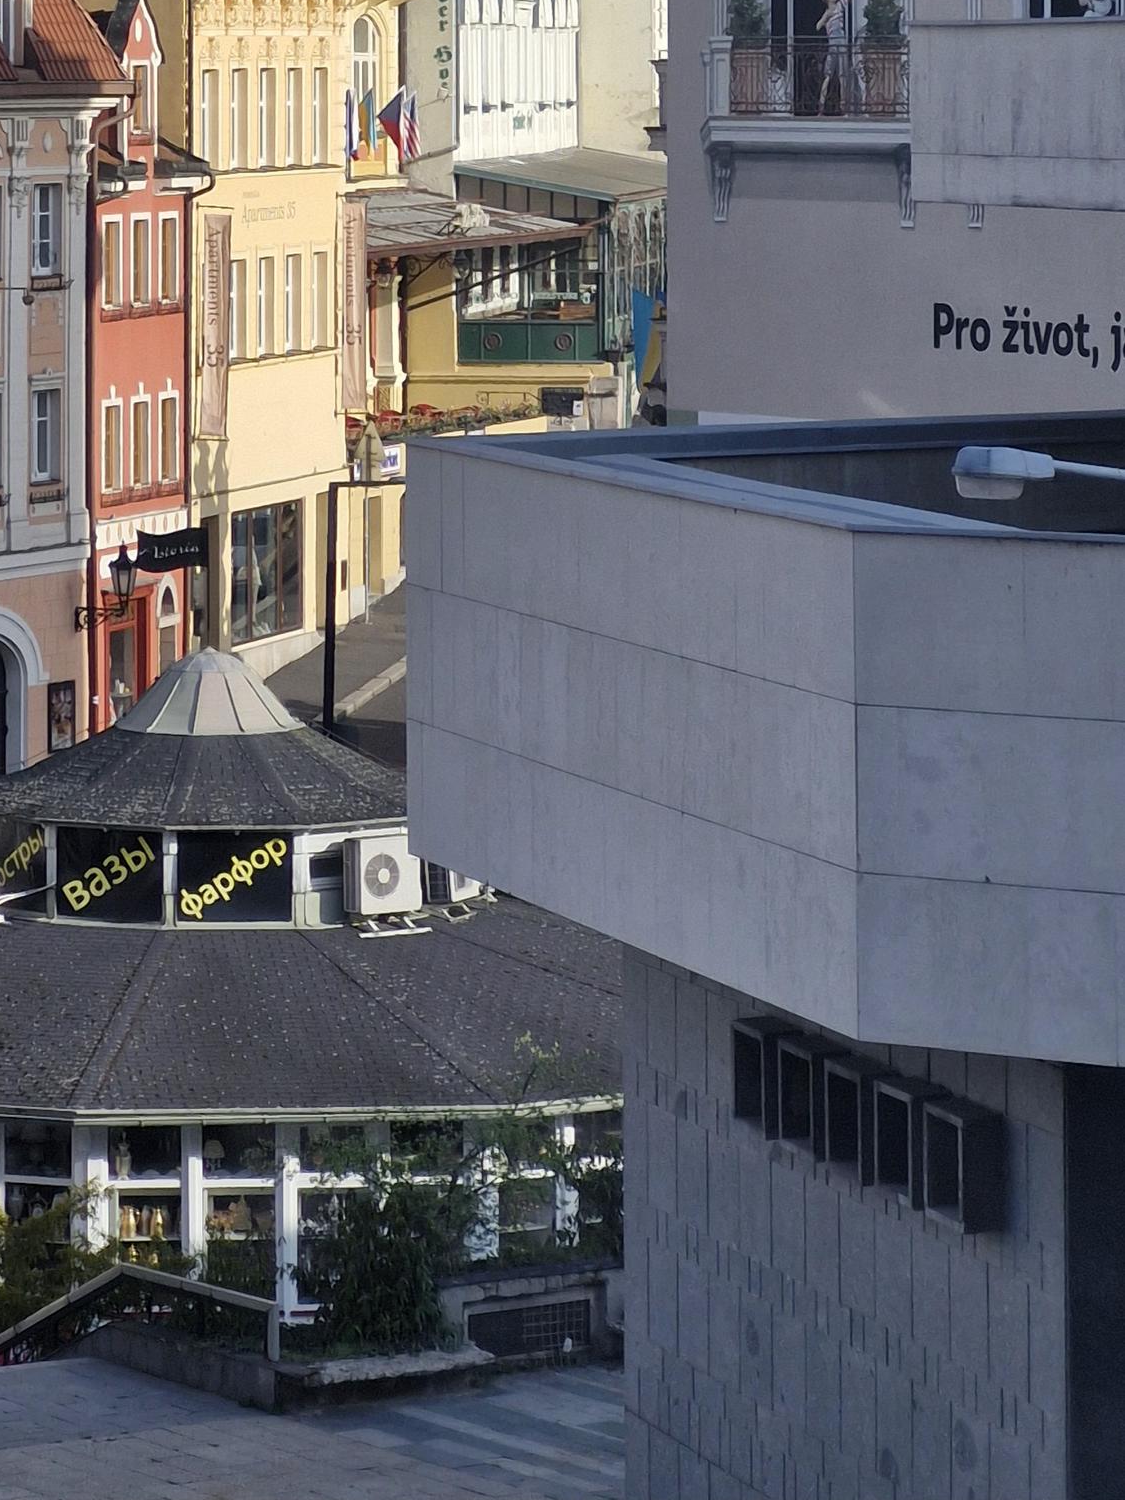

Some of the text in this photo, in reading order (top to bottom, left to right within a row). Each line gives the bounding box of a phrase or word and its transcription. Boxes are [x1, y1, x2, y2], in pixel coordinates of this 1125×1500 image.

[205, 227, 224, 368] Apartments 35
[343, 213, 362, 346] Apartments 35
[933, 302, 1125, 373] Pro život, j
